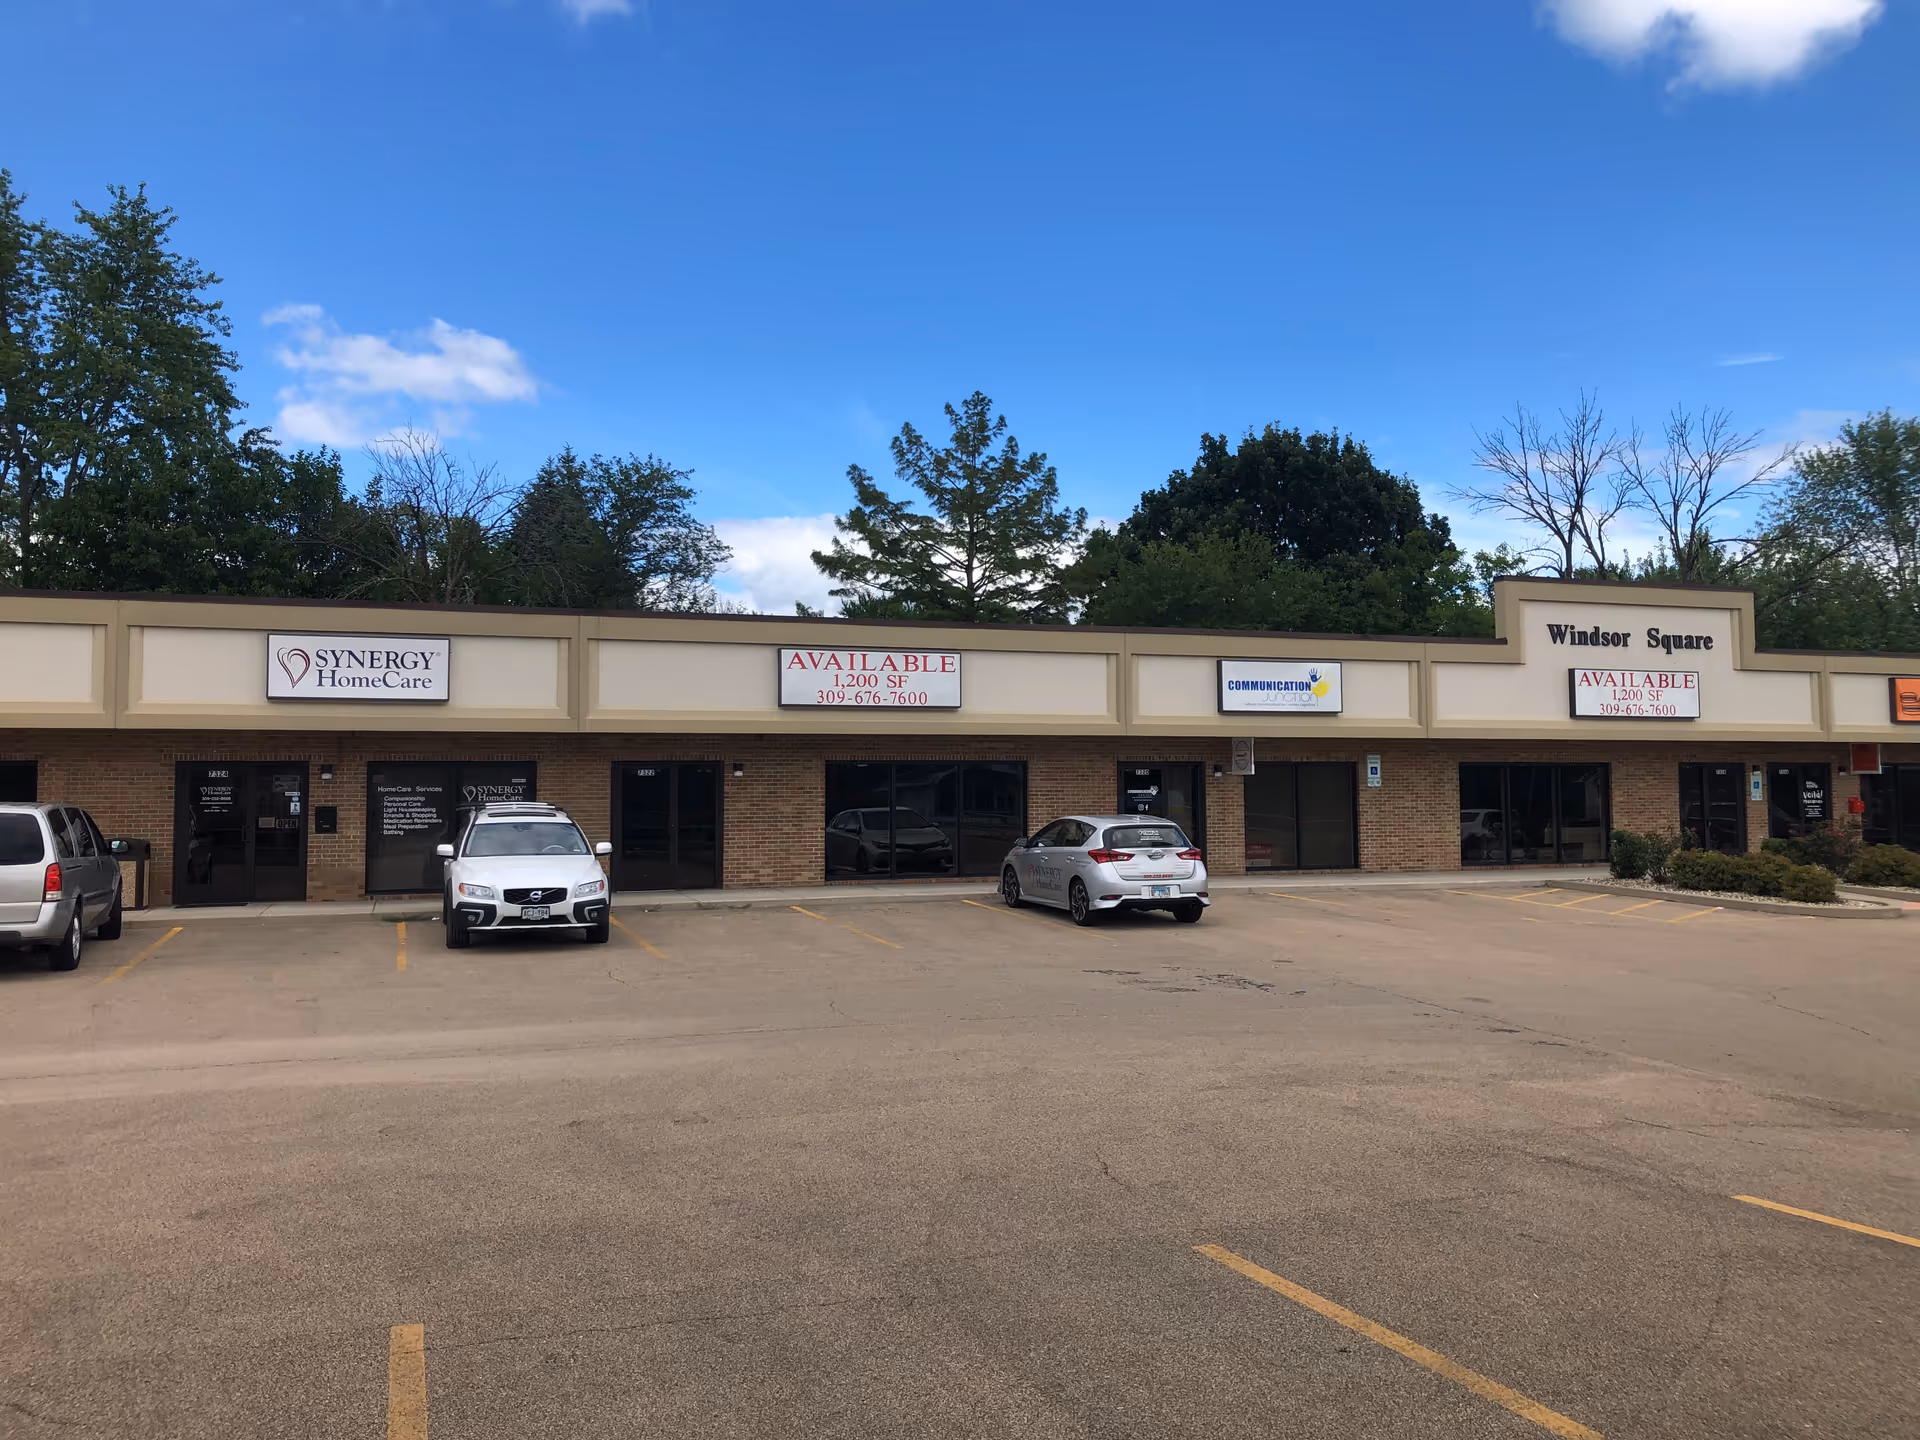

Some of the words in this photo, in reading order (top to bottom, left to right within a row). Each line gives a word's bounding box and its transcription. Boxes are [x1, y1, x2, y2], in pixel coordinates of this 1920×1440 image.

[1547, 624, 1631, 647] Windsor
[1647, 628, 1714, 655] Square
[315, 648, 435, 670] SYNERGY
[786, 651, 957, 673] AVAILABLE
[316, 669, 433, 689] HomeCare
[833, 673, 879, 690] 1,200
[886, 675, 909, 688] SF
[1228, 680, 1312, 692] COMMUNICATION
[1578, 671, 1696, 689] AVAILABLE
[816, 690, 928, 705] 309-676-7600
[1612, 689, 1643, 703] 1,200
[1648, 690, 1664, 701] SF
[1600, 703, 1676, 716] 309-676-7600
[416, 785, 443, 793] Services
[477, 785, 524, 794] SYNERGY
[478, 793, 524, 801] HomeCare
[277, 818, 298, 828] OPEN
